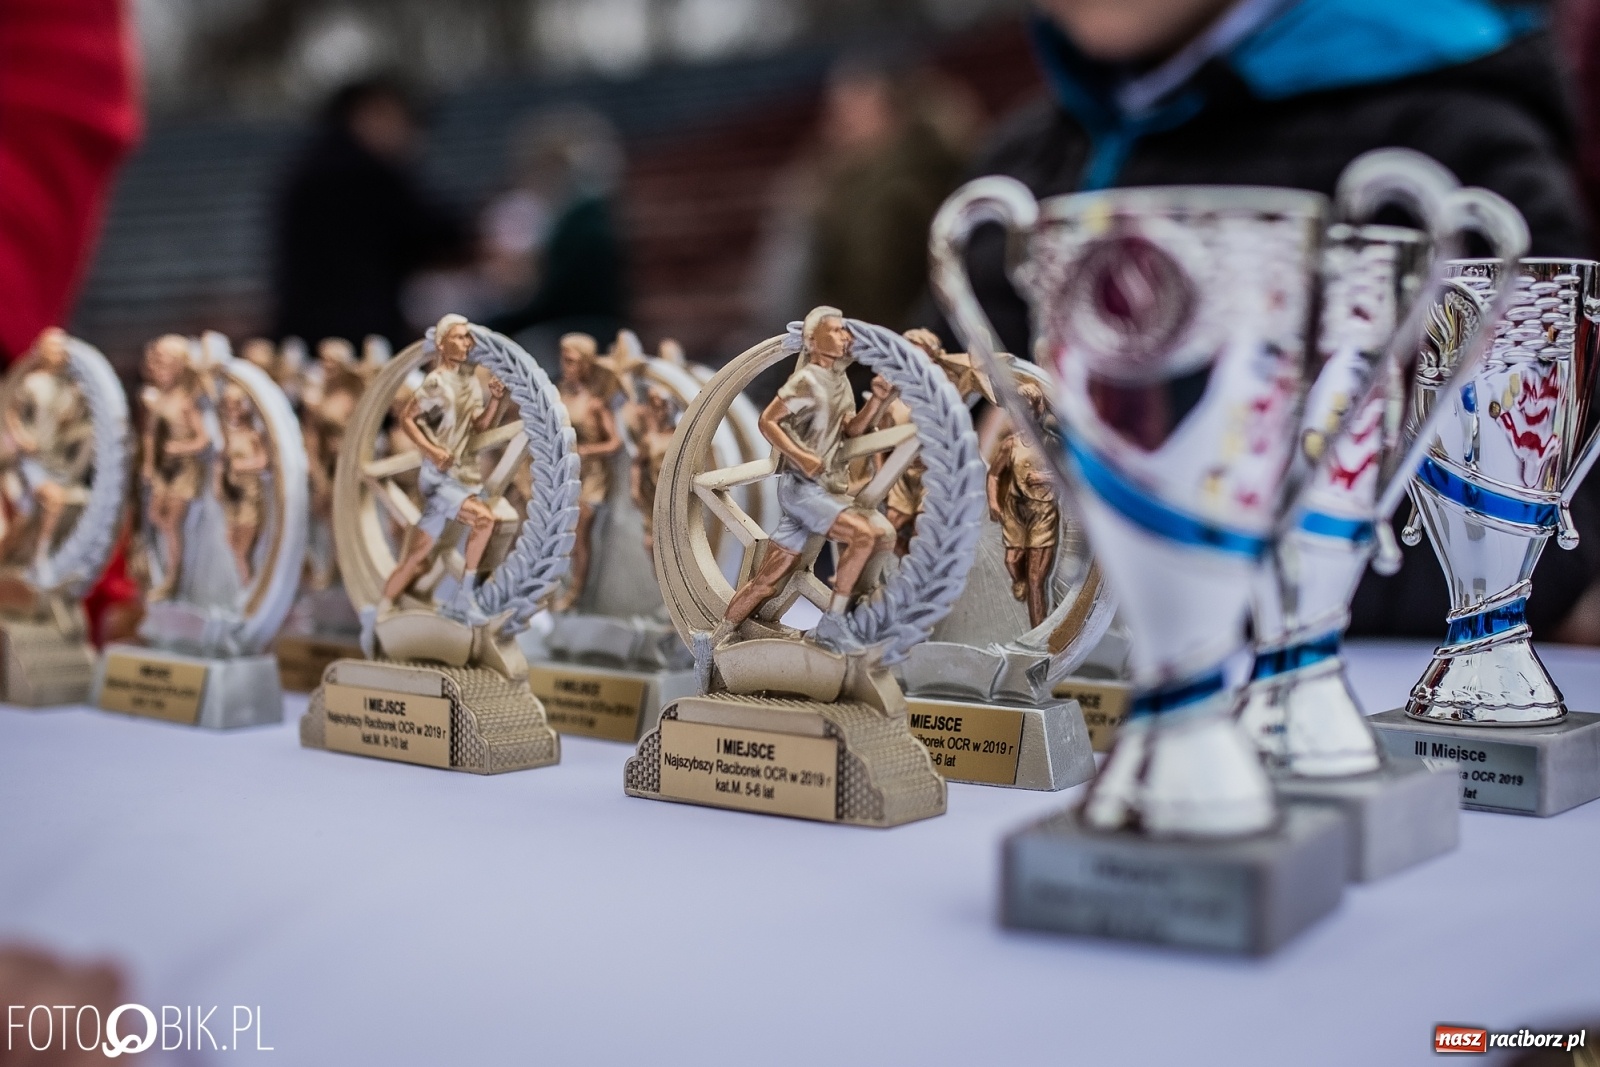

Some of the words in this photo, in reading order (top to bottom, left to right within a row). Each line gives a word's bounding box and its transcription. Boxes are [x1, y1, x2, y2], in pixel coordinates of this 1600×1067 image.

[369, 697, 406, 716] MIEJSCE
[398, 720, 415, 735] OCR
[416, 726, 423, 736] w
[424, 724, 441, 739] 2019
[910, 713, 963, 732] MIEJSCE
[716, 738, 721, 753] I
[723, 738, 776, 760] MIEJSCE
[947, 736, 970, 752] OCR
[972, 742, 981, 752] w
[982, 740, 1007, 755] 2019
[1008, 745, 1014, 755] r
[1414, 740, 1427, 756] III
[1431, 742, 1487, 763] Miejsce
[664, 752, 714, 775] Najszybszy
[716, 759, 762, 778] Raciborek
[763, 767, 787, 783] OCR
[789, 773, 798, 783] w
[799, 770, 825, 787] 2019
[944, 753, 957, 767] lat
[1471, 770, 1496, 783] OCR
[1498, 773, 1524, 786] 2019
[745, 781, 761, 798] 5-6
[762, 784, 775, 800] lat
[1463, 786, 1478, 799] lat
